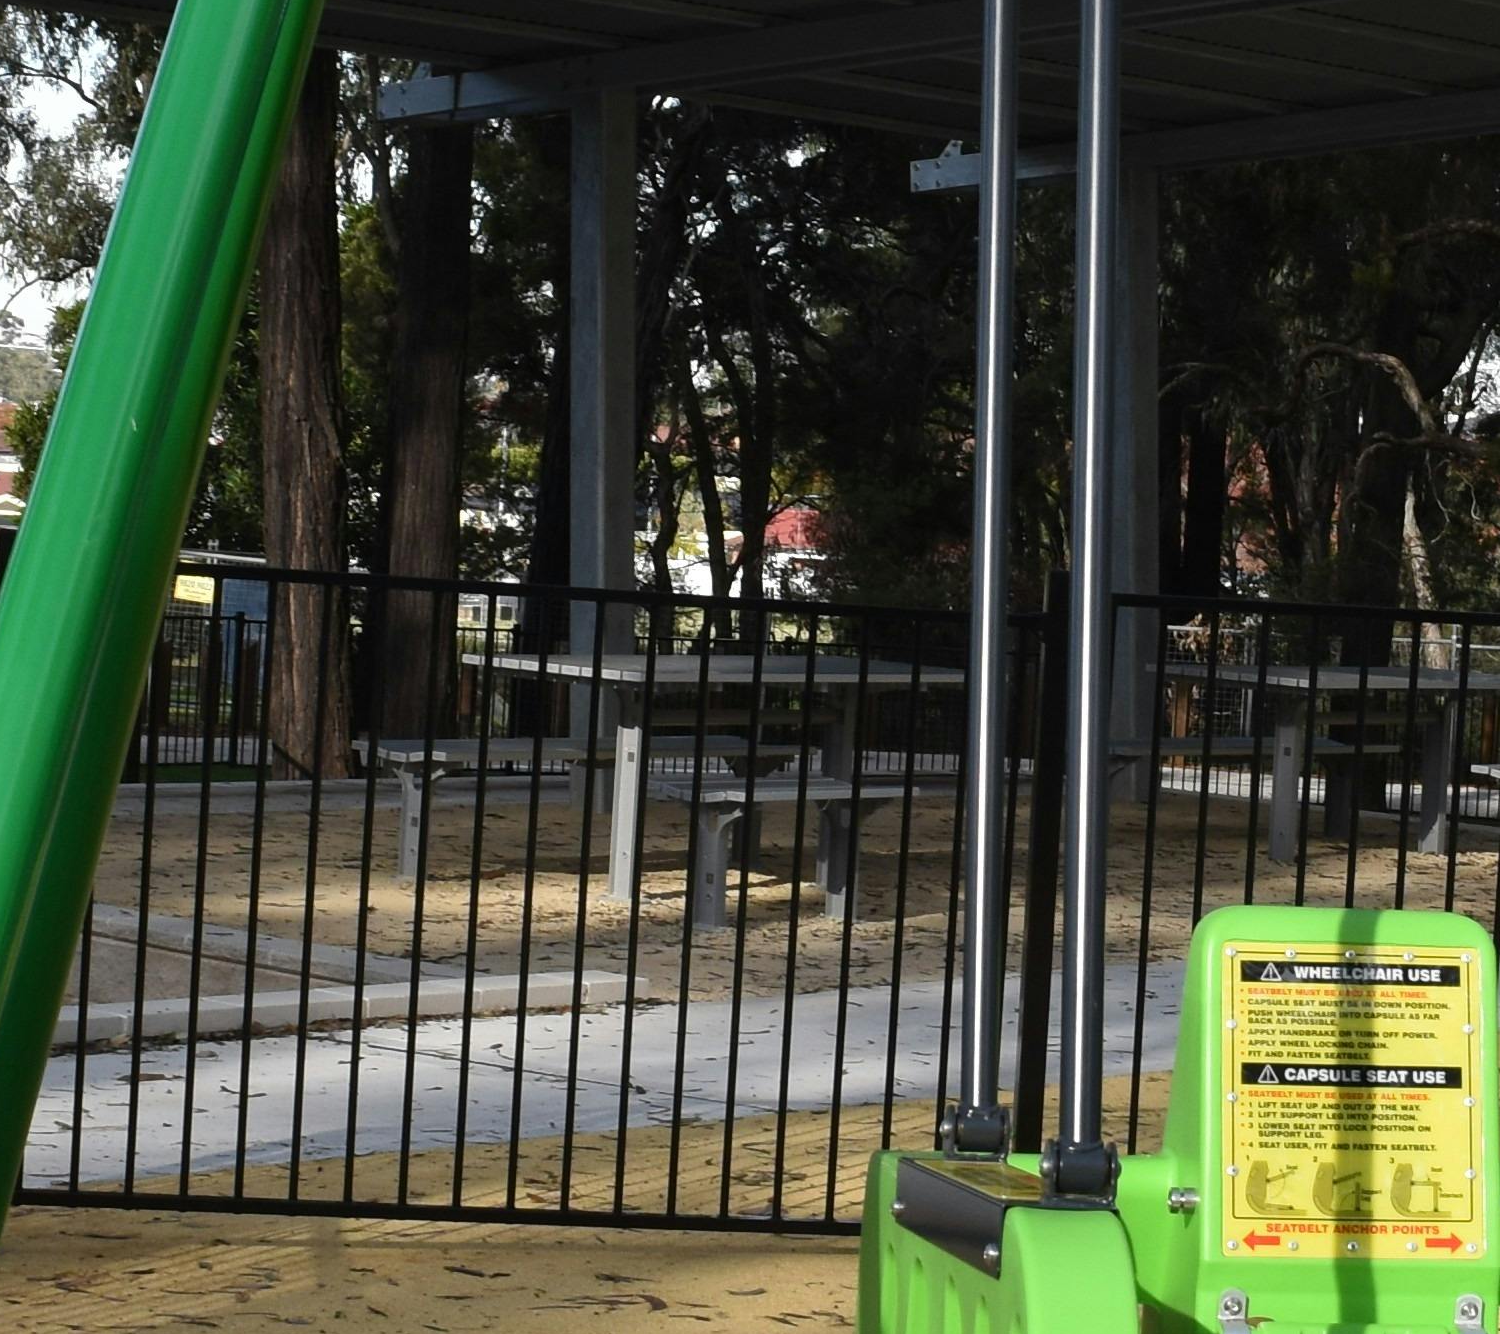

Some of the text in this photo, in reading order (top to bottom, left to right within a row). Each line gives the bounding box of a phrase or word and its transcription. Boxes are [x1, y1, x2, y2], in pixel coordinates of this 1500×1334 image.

[1294, 965, 1442, 983] WHEELCHAIR USE
[1248, 988, 1293, 996] SEATBELT
[1295, 989, 1321, 997] MUST
[1248, 998, 1290, 1007] CAPSULE
[1293, 999, 1317, 1007] SEAT
[1319, 1000, 1345, 1008] MUST
[1374, 1001, 1401, 1009] DOWN
[1405, 1002, 1451, 1010] POSITION.
[1276, 1010, 1337, 1018] WHEELCHAIR
[1339, 1011, 1361, 1019] INTO
[1364, 1012, 1406, 1020] CAPSULE
[1423, 1013, 1441, 1021] FAR
[1248, 1017, 1273, 1025] BACK
[1290, 1019, 1339, 1027] POSSIBLE.
[1280, 1029, 1336, 1038] HANDBRAKE
[1339, 1030, 1352, 1038] OR
[1382, 1031, 1399, 1039] OFF
[1402, 1032, 1438, 1040] POWER.
[1279, 1040, 1311, 1048] WHEEL
[1313, 1041, 1355, 1049] LOCKING
[1358, 1041, 1389, 1050] CHAIN.
[1248, 1050, 1262, 1058] FIT
[1287, 1051, 1322, 1059] FASTEN
[1284, 1068, 1447, 1084] CAPSULE SEAT USE
[1248, 1090, 1293, 1098] SEATBELT
[1296, 1091, 1322, 1099] MUST
[1339, 1092, 1364, 1100] USED
[1400, 1104, 1421, 1112] WAY.
[1258, 1111, 1278, 1119] LIFT
[1280, 1112, 1323, 1120] SUPPORT
[1293, 1123, 1316, 1131] SEAT
[1343, 1124, 1368, 1132] LOCK
[1418, 1125, 1431, 1133] ON
[1258, 1130, 1302, 1138] SUPPORT
[1284, 1142, 1312, 1150] USER,
[1390, 1144, 1438, 1152] SEATBELT.
[1313, 1155, 1318, 1163] 2
[1266, 1223, 1440, 1235] SEATBELT ANCHOR POINTS
